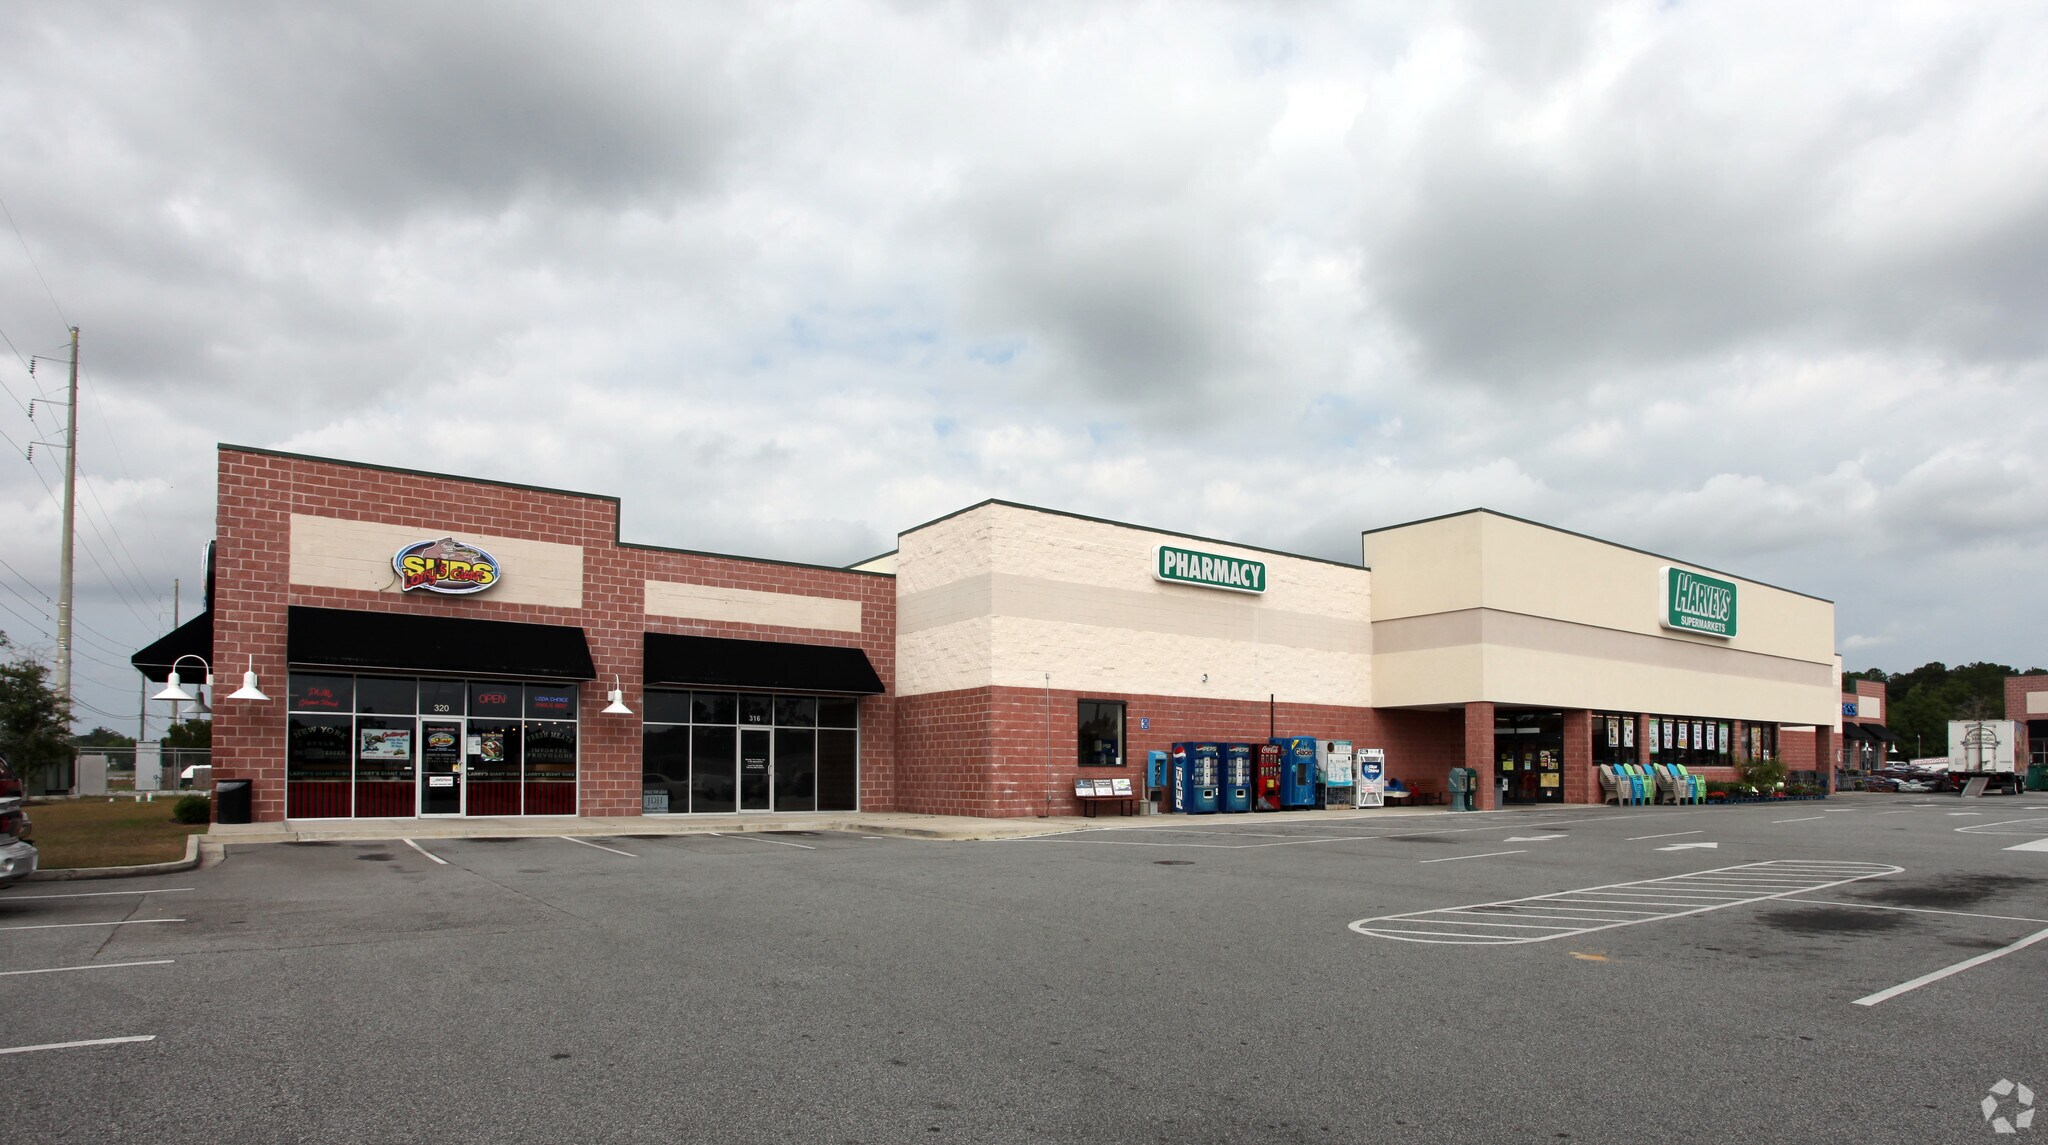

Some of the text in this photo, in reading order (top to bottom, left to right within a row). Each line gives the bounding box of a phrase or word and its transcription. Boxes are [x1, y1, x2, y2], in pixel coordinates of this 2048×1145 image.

[403, 555, 494, 584] SUBS
[1164, 550, 1261, 588] PHARMACY
[1675, 573, 1731, 621] HARVEYS
[1681, 616, 1726, 633] SUPERMARKETS
[479, 694, 507, 704] OPEN
[433, 704, 449, 712] 320
[293, 726, 348, 740] NEW YORK
[526, 731, 574, 744] FRESH MEATS
[1295, 748, 1313, 756] Glacier
[1175, 766, 1183, 810] PEPSI
